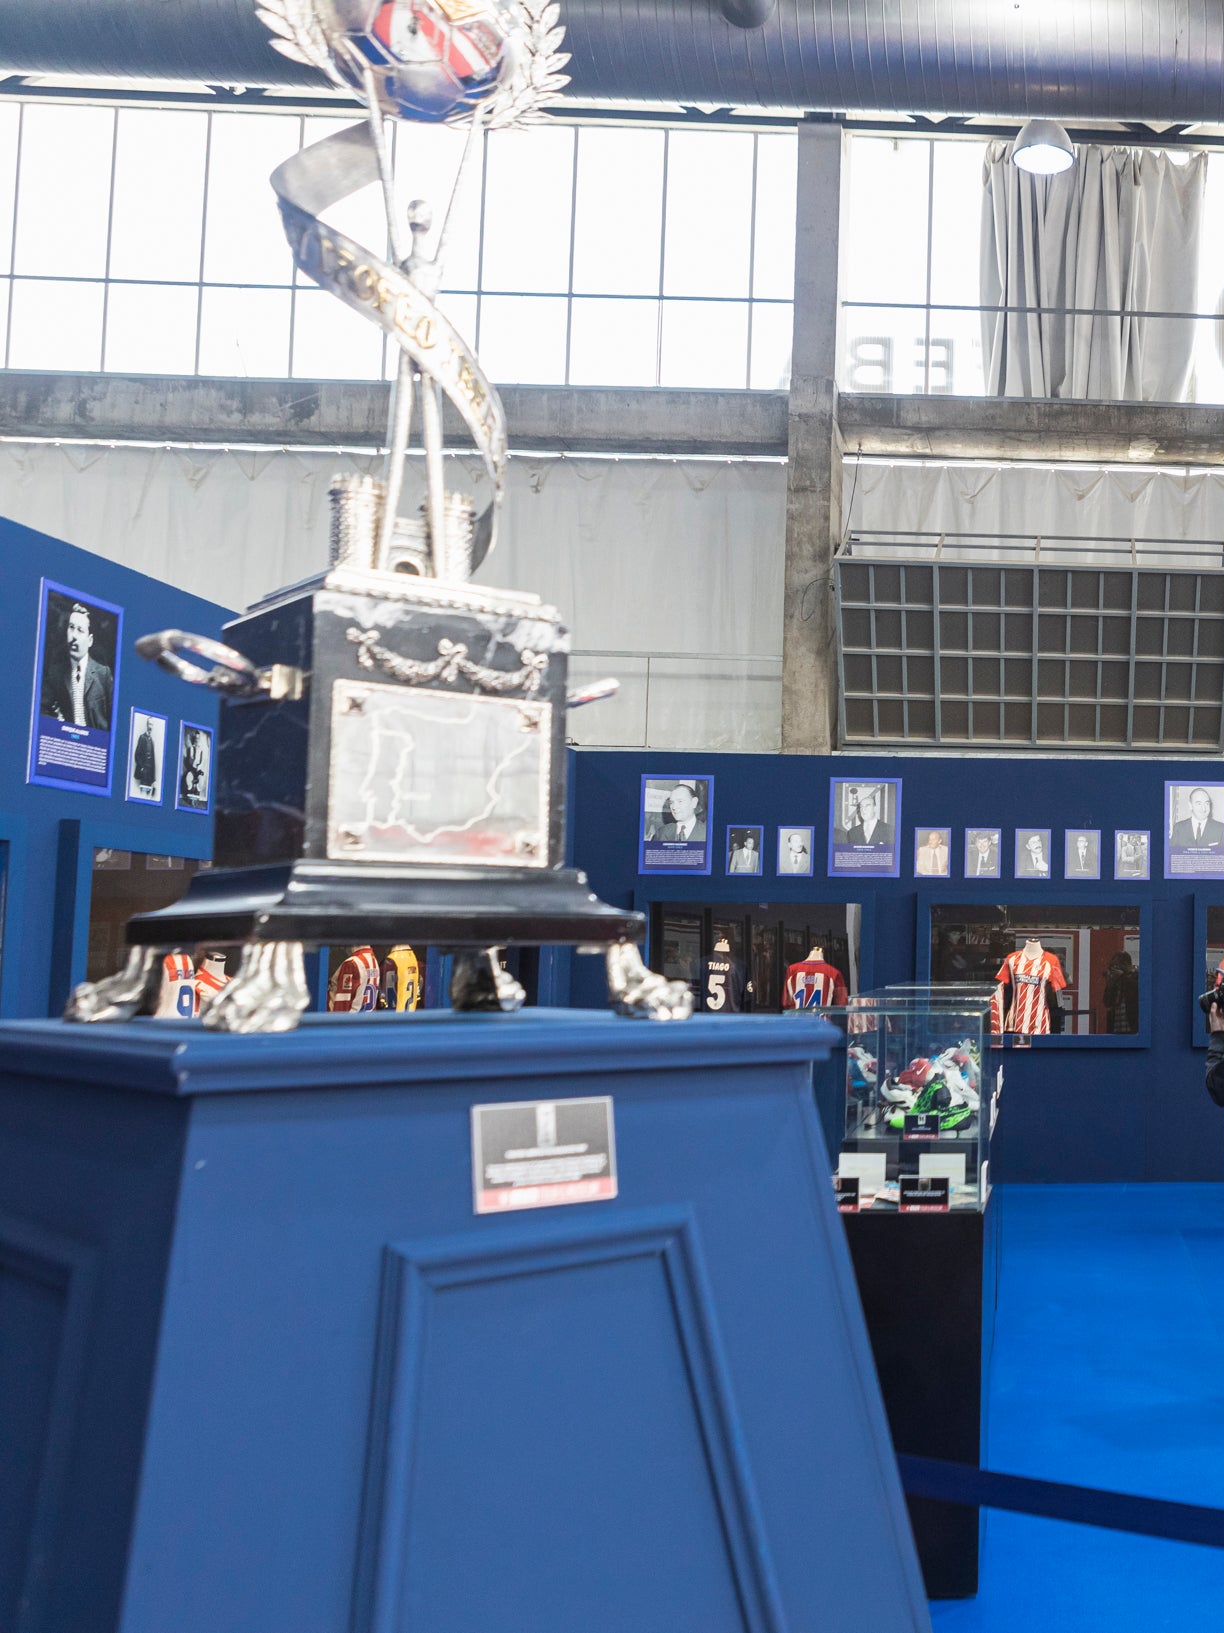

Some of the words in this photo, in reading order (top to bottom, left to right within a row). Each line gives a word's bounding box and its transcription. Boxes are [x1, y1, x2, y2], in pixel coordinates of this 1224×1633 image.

[707, 961, 730, 972] TIAGO
[706, 974, 726, 1010] 5
[793, 988, 824, 1008] 14
